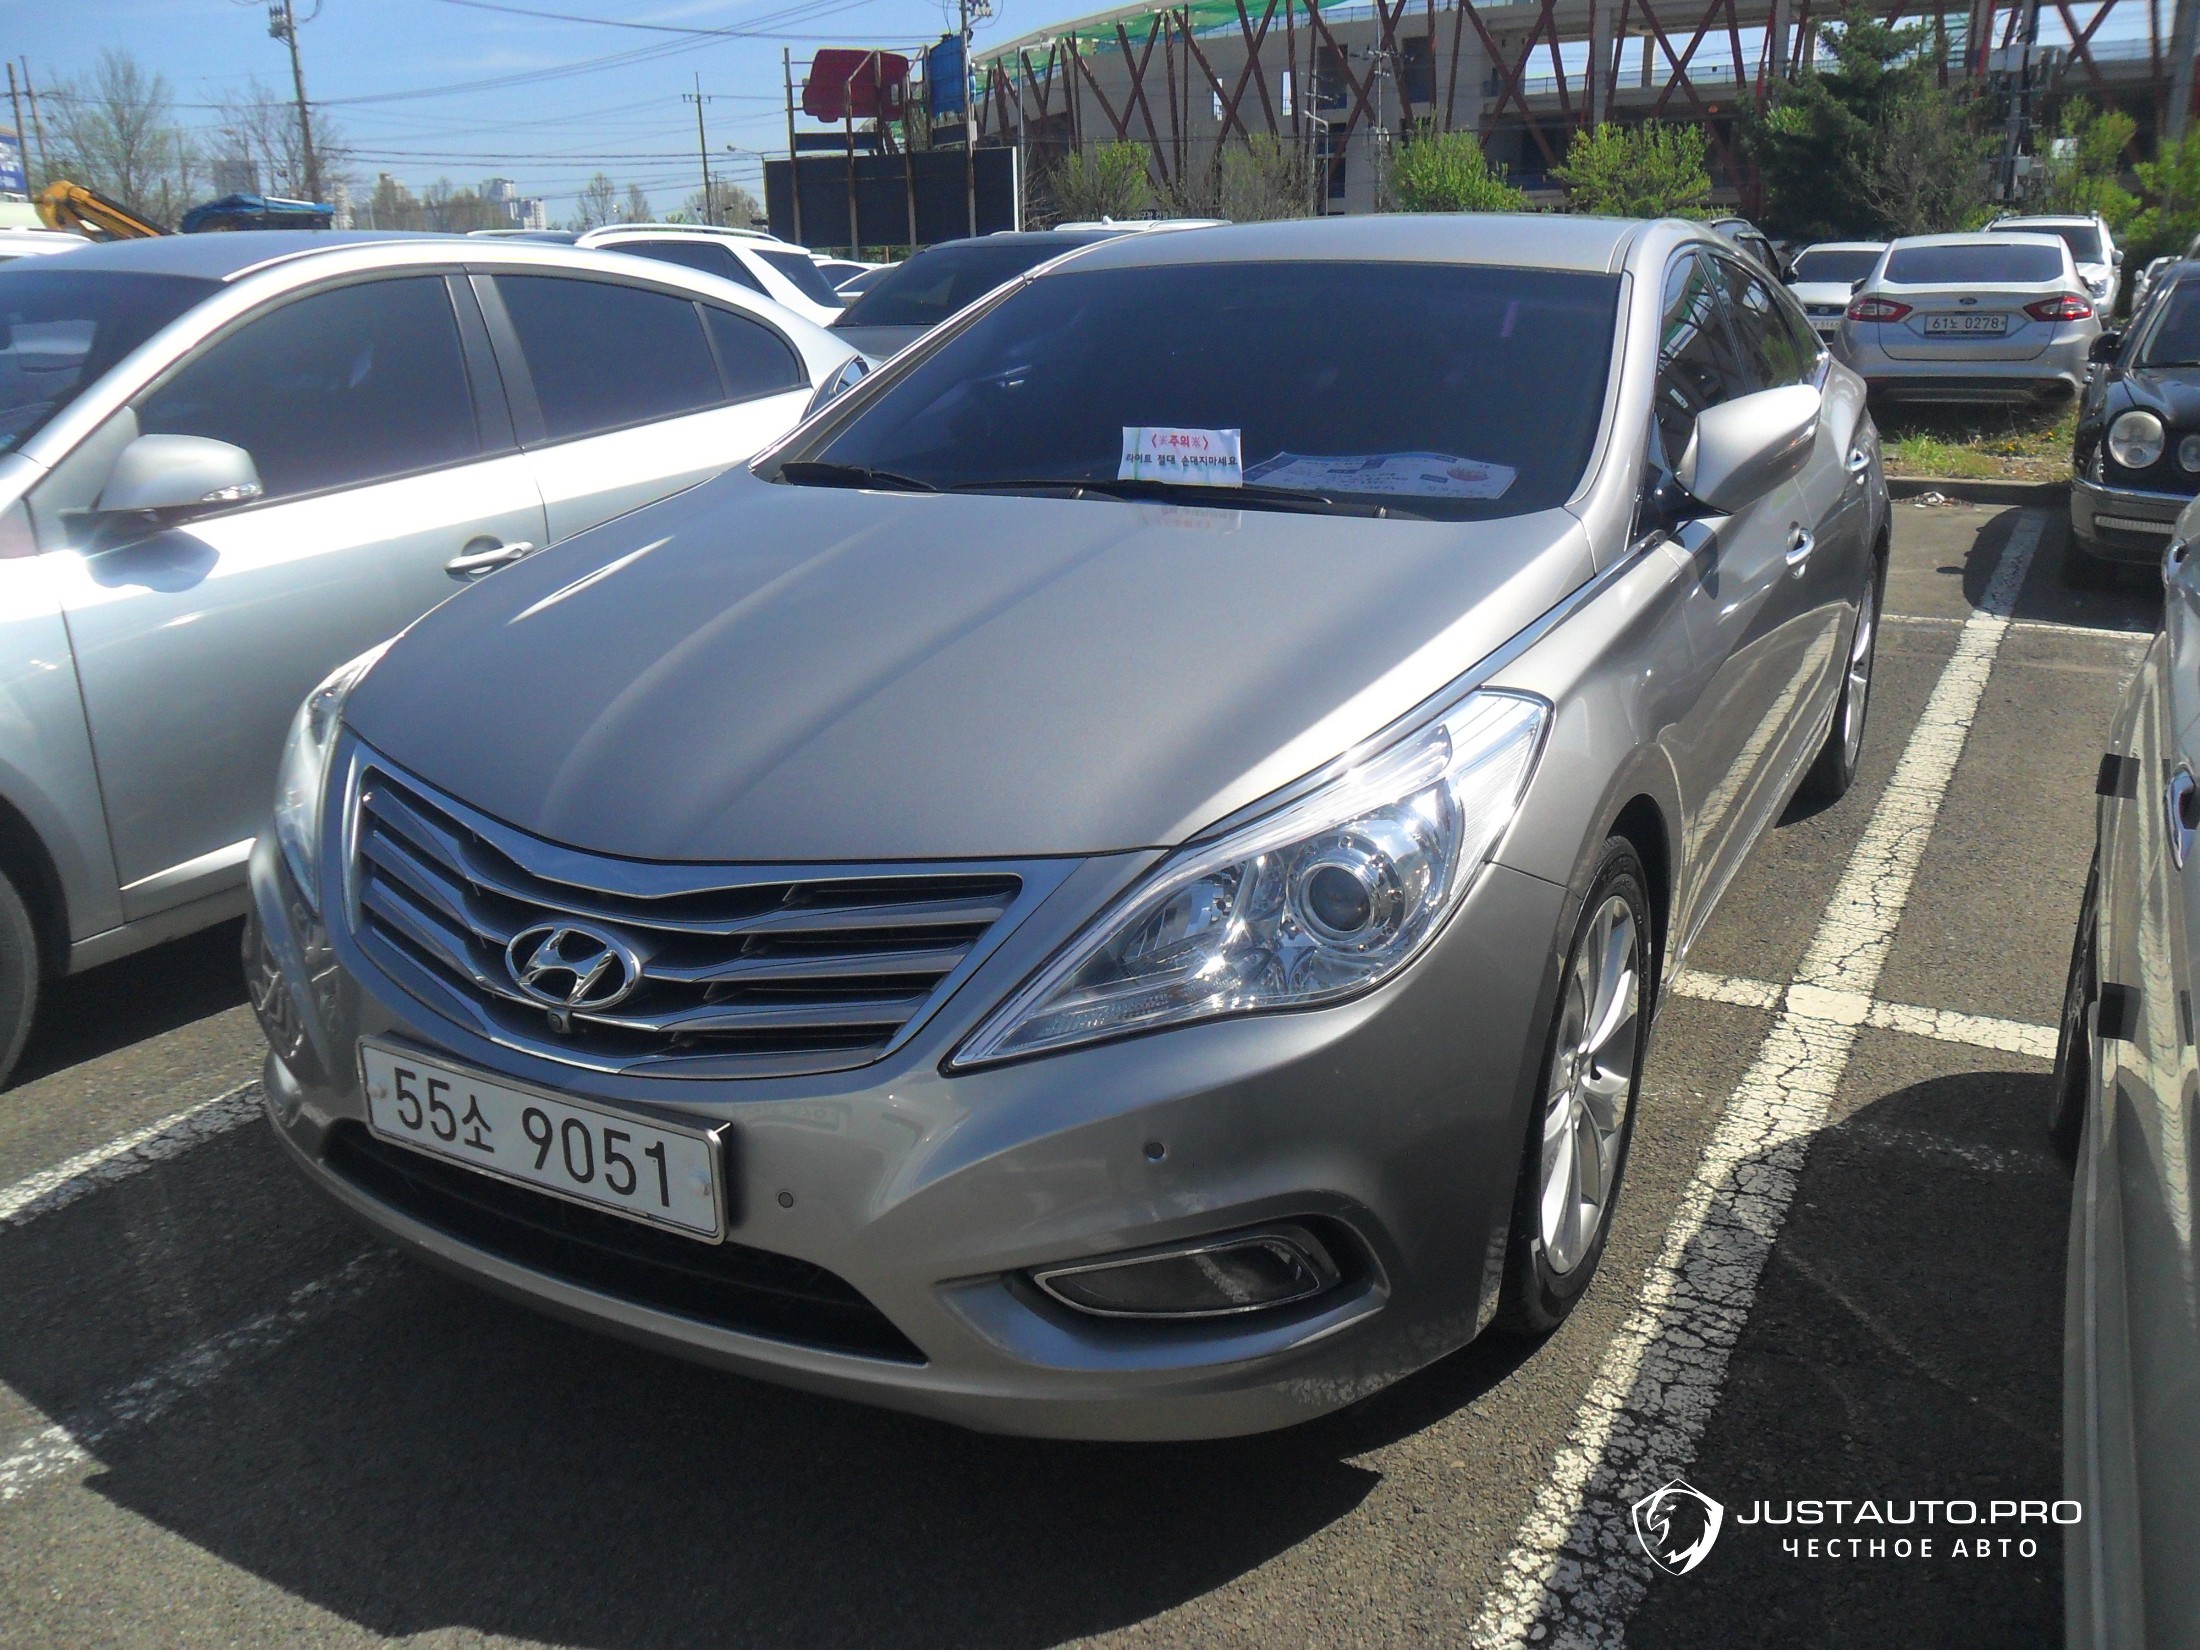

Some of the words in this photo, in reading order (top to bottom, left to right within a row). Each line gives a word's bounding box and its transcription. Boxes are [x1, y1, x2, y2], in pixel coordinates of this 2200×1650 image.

[1932, 317, 1958, 329] 61노
[1965, 317, 1998, 329] 0278
[1126, 453, 1152, 463] 라이트
[1157, 454, 1176, 465] 절대
[1181, 455, 1238, 467] 손대지마세요
[394, 1067, 494, 1153] 55소
[522, 1107, 669, 1207] 9051
